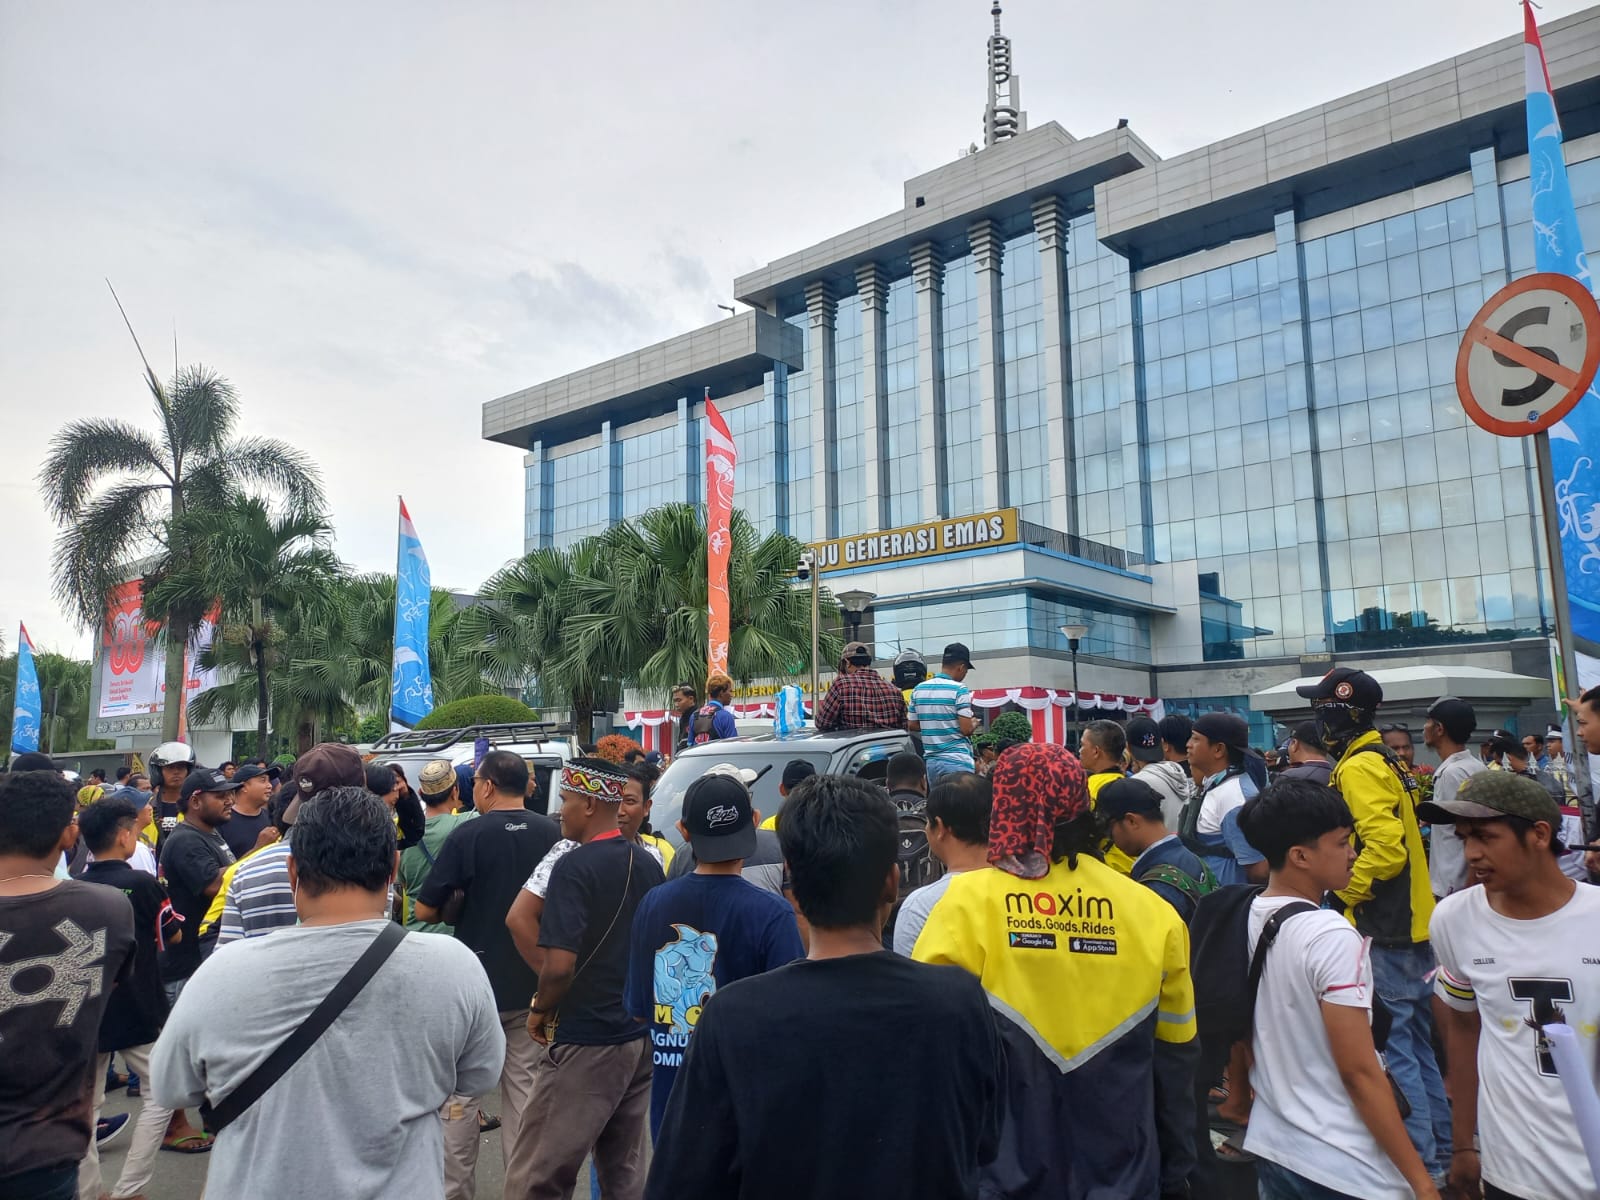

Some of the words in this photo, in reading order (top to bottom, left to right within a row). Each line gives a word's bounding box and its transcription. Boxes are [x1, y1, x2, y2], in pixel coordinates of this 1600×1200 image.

[814, 543, 839, 568] JU
[845, 527, 936, 563] GENERASI
[943, 515, 1004, 548] EMAS
[1005, 888, 1114, 920] maxim
[1021, 937, 1042, 946] Google
